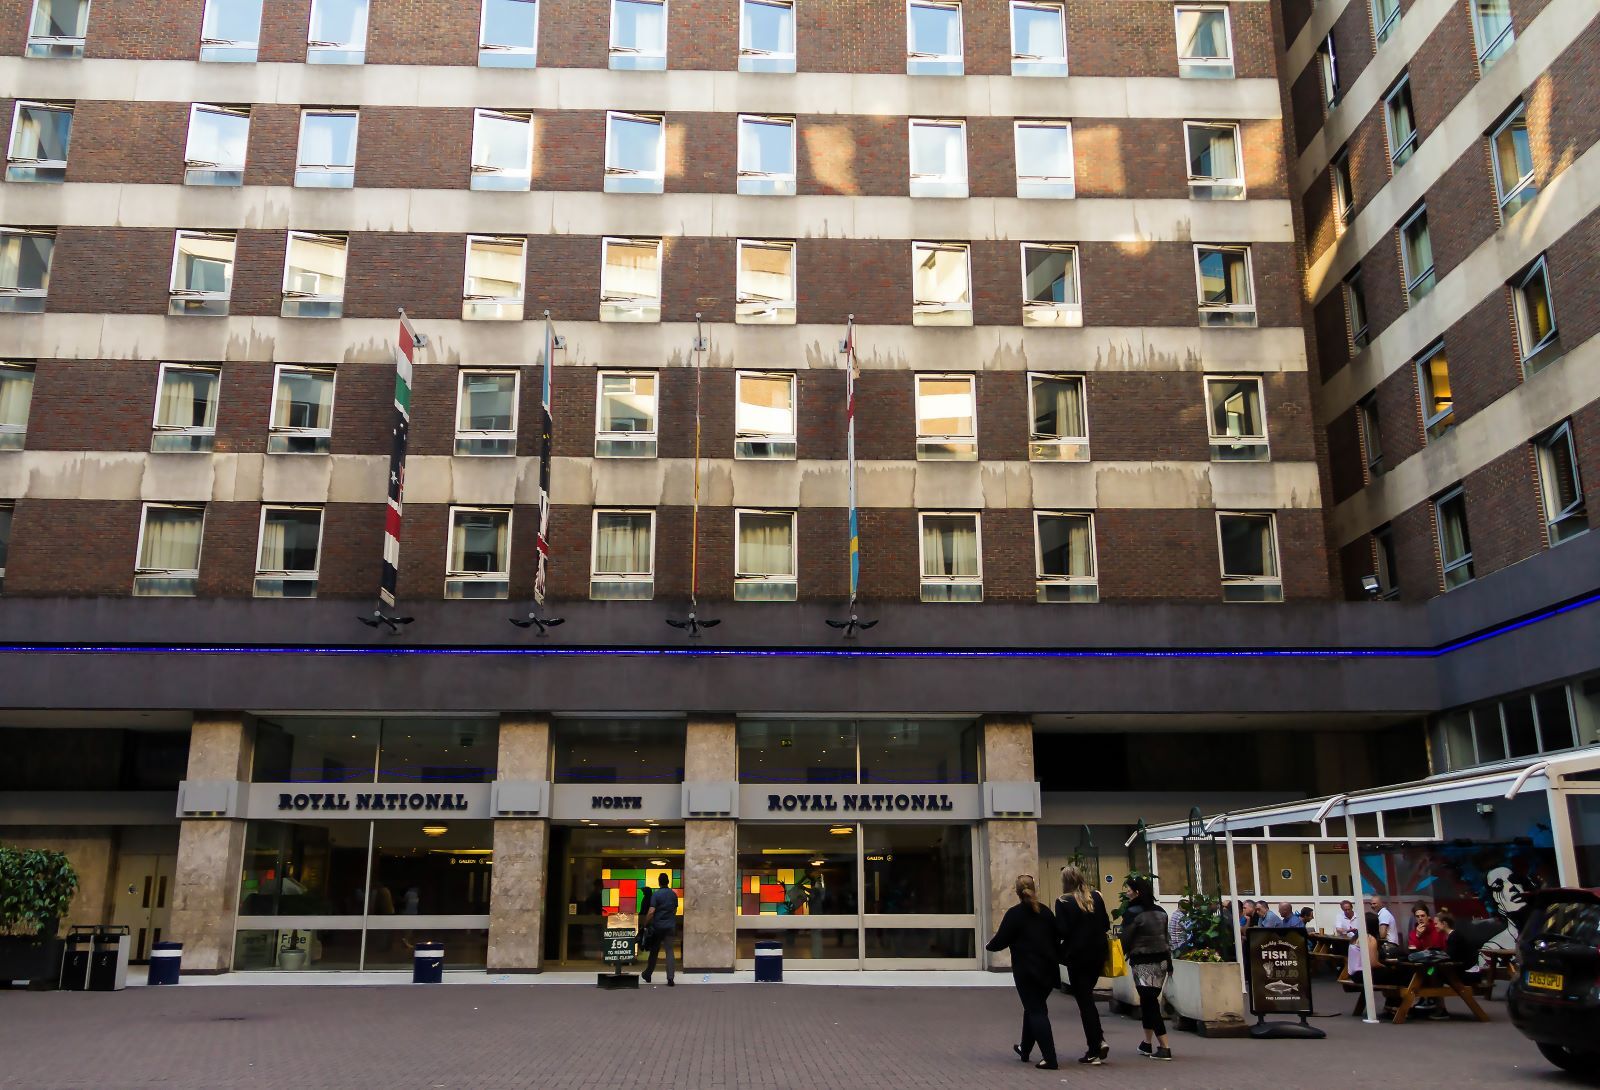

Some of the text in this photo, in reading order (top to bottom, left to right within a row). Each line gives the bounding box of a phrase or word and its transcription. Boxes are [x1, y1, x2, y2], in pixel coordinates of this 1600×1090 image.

[278, 793, 468, 810] ROYAL NATIONAL
[592, 796, 642, 809] NORTH
[768, 794, 953, 811] ROYAL NATIONAL
[611, 939, 629, 949] £50
[1261, 950, 1287, 960] FISH
